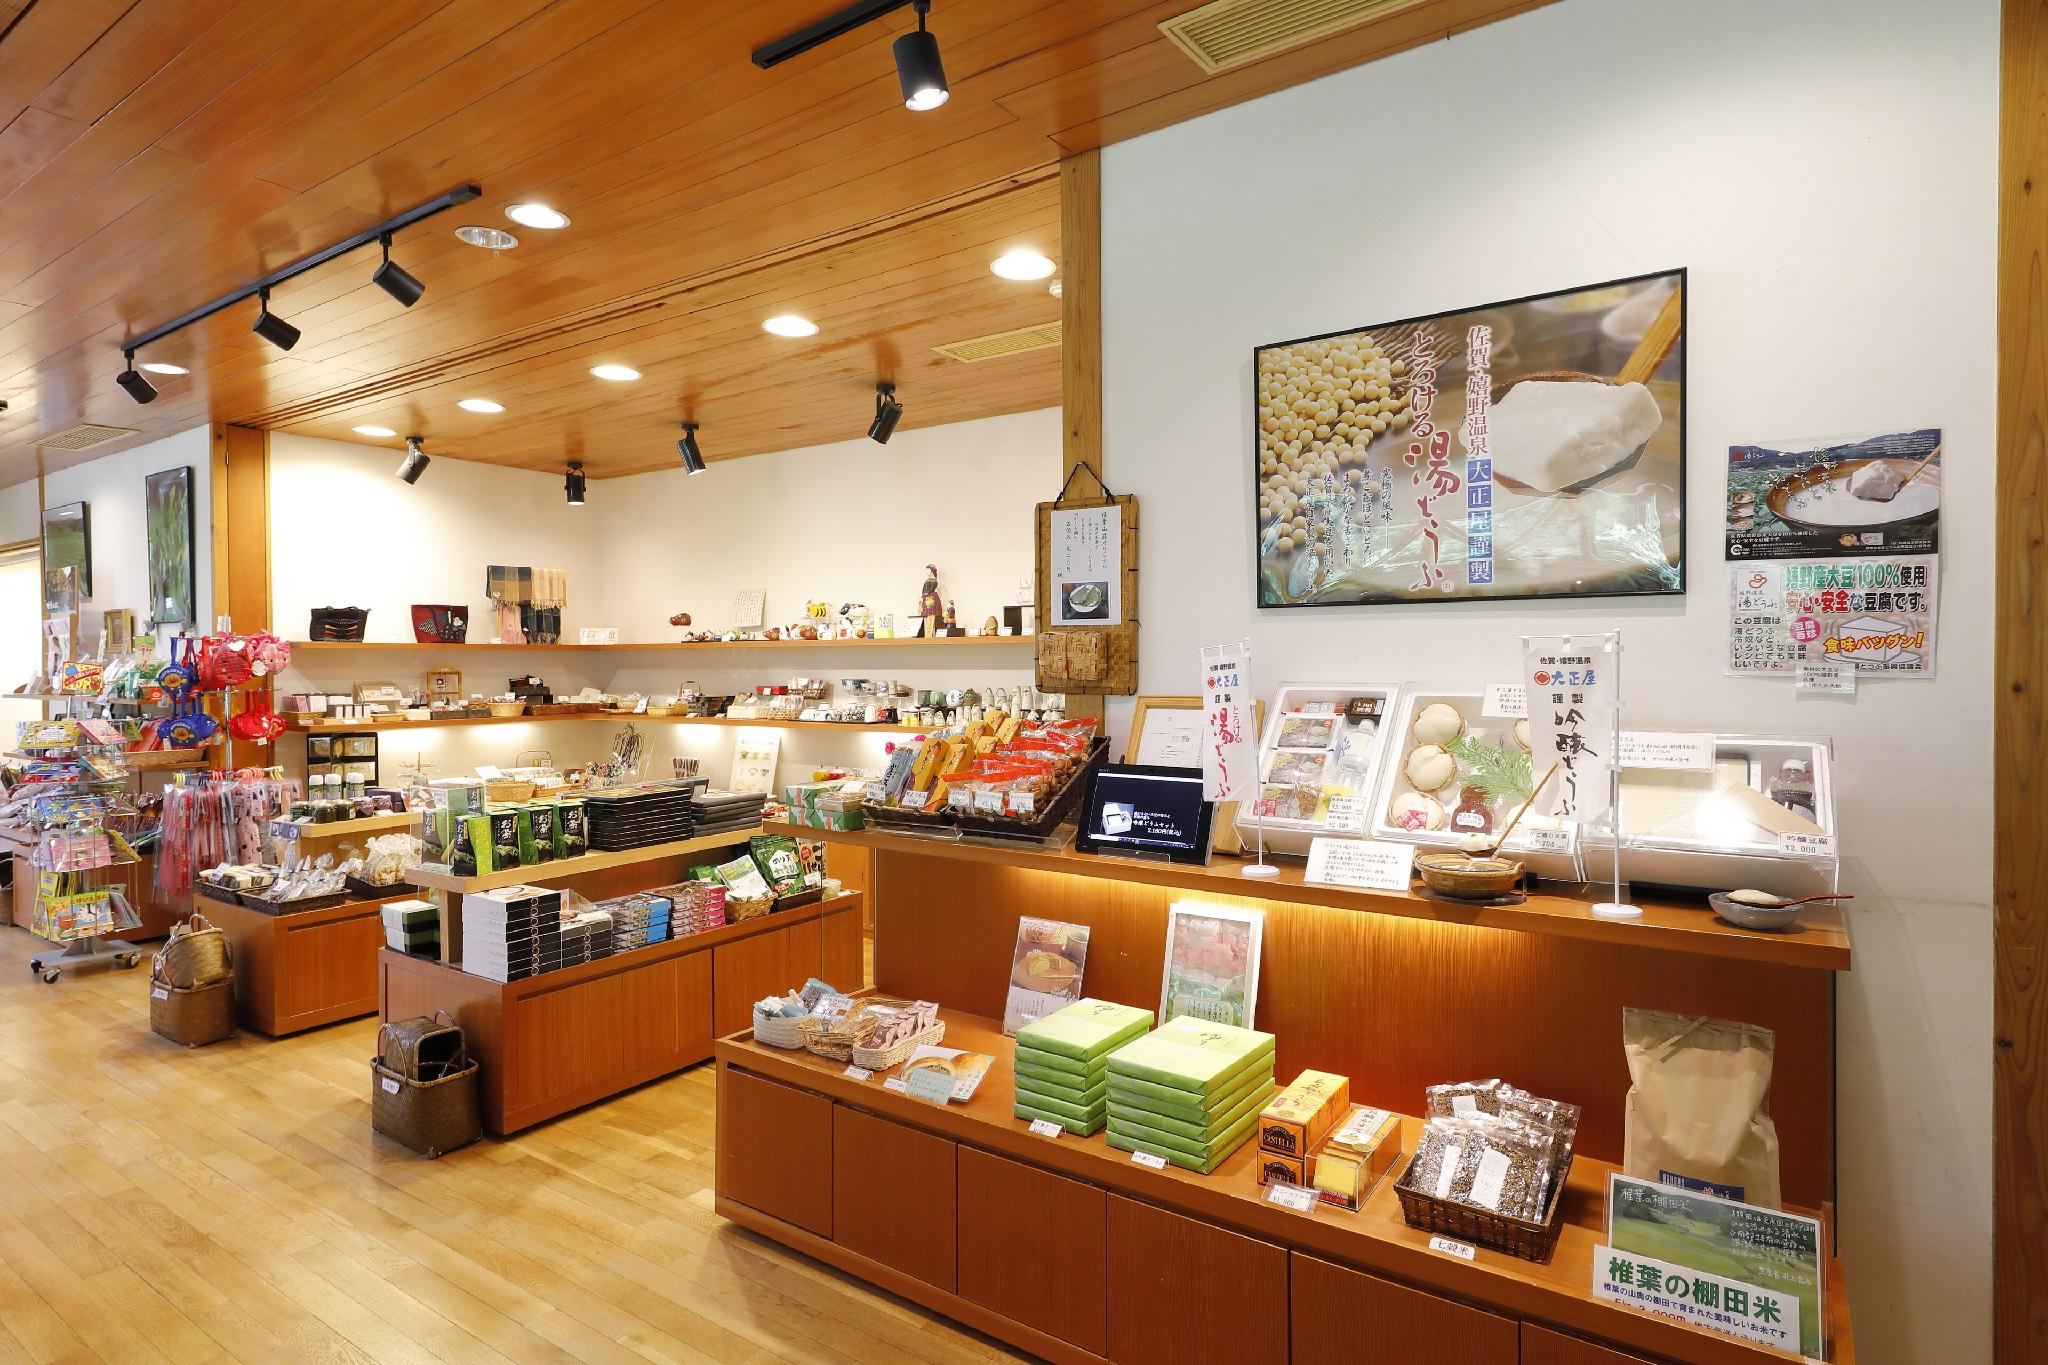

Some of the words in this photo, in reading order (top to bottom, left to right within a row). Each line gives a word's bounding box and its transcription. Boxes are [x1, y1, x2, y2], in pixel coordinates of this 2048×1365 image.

[1786, 563, 1927, 589] 嬉野産大豆100%使用
[1786, 589, 1928, 614] 安心・安全な豆腐です。
[1734, 644, 1807, 652] いろいろな豆腐
[1734, 652, 1807, 660] レシピでも美味
[1539, 656, 1592, 665] 佐賀・嬉野温泉
[1734, 660, 1784, 669] しいですよ。
[1550, 669, 1597, 687] 大正屋
[1232, 704, 1243, 744] とろける
[1210, 707, 1235, 799] 湯どうふ
[1553, 707, 1599, 817] 吟醸どうふ
[500, 819, 513, 839] お茶
[538, 814, 549, 834] お茶
[566, 810, 579, 830] お茶
[1785, 845, 1817, 854] ¥2,000
[1263, 1133, 1296, 1150] CASTELLA
[1435, 1240, 1470, 1256] 七穀米
[1608, 1255, 1783, 1325] 椎葉の棚田米
[1603, 1282, 1789, 1340] 椎葉の山奥の棚田で育まれた美味しいお米です
